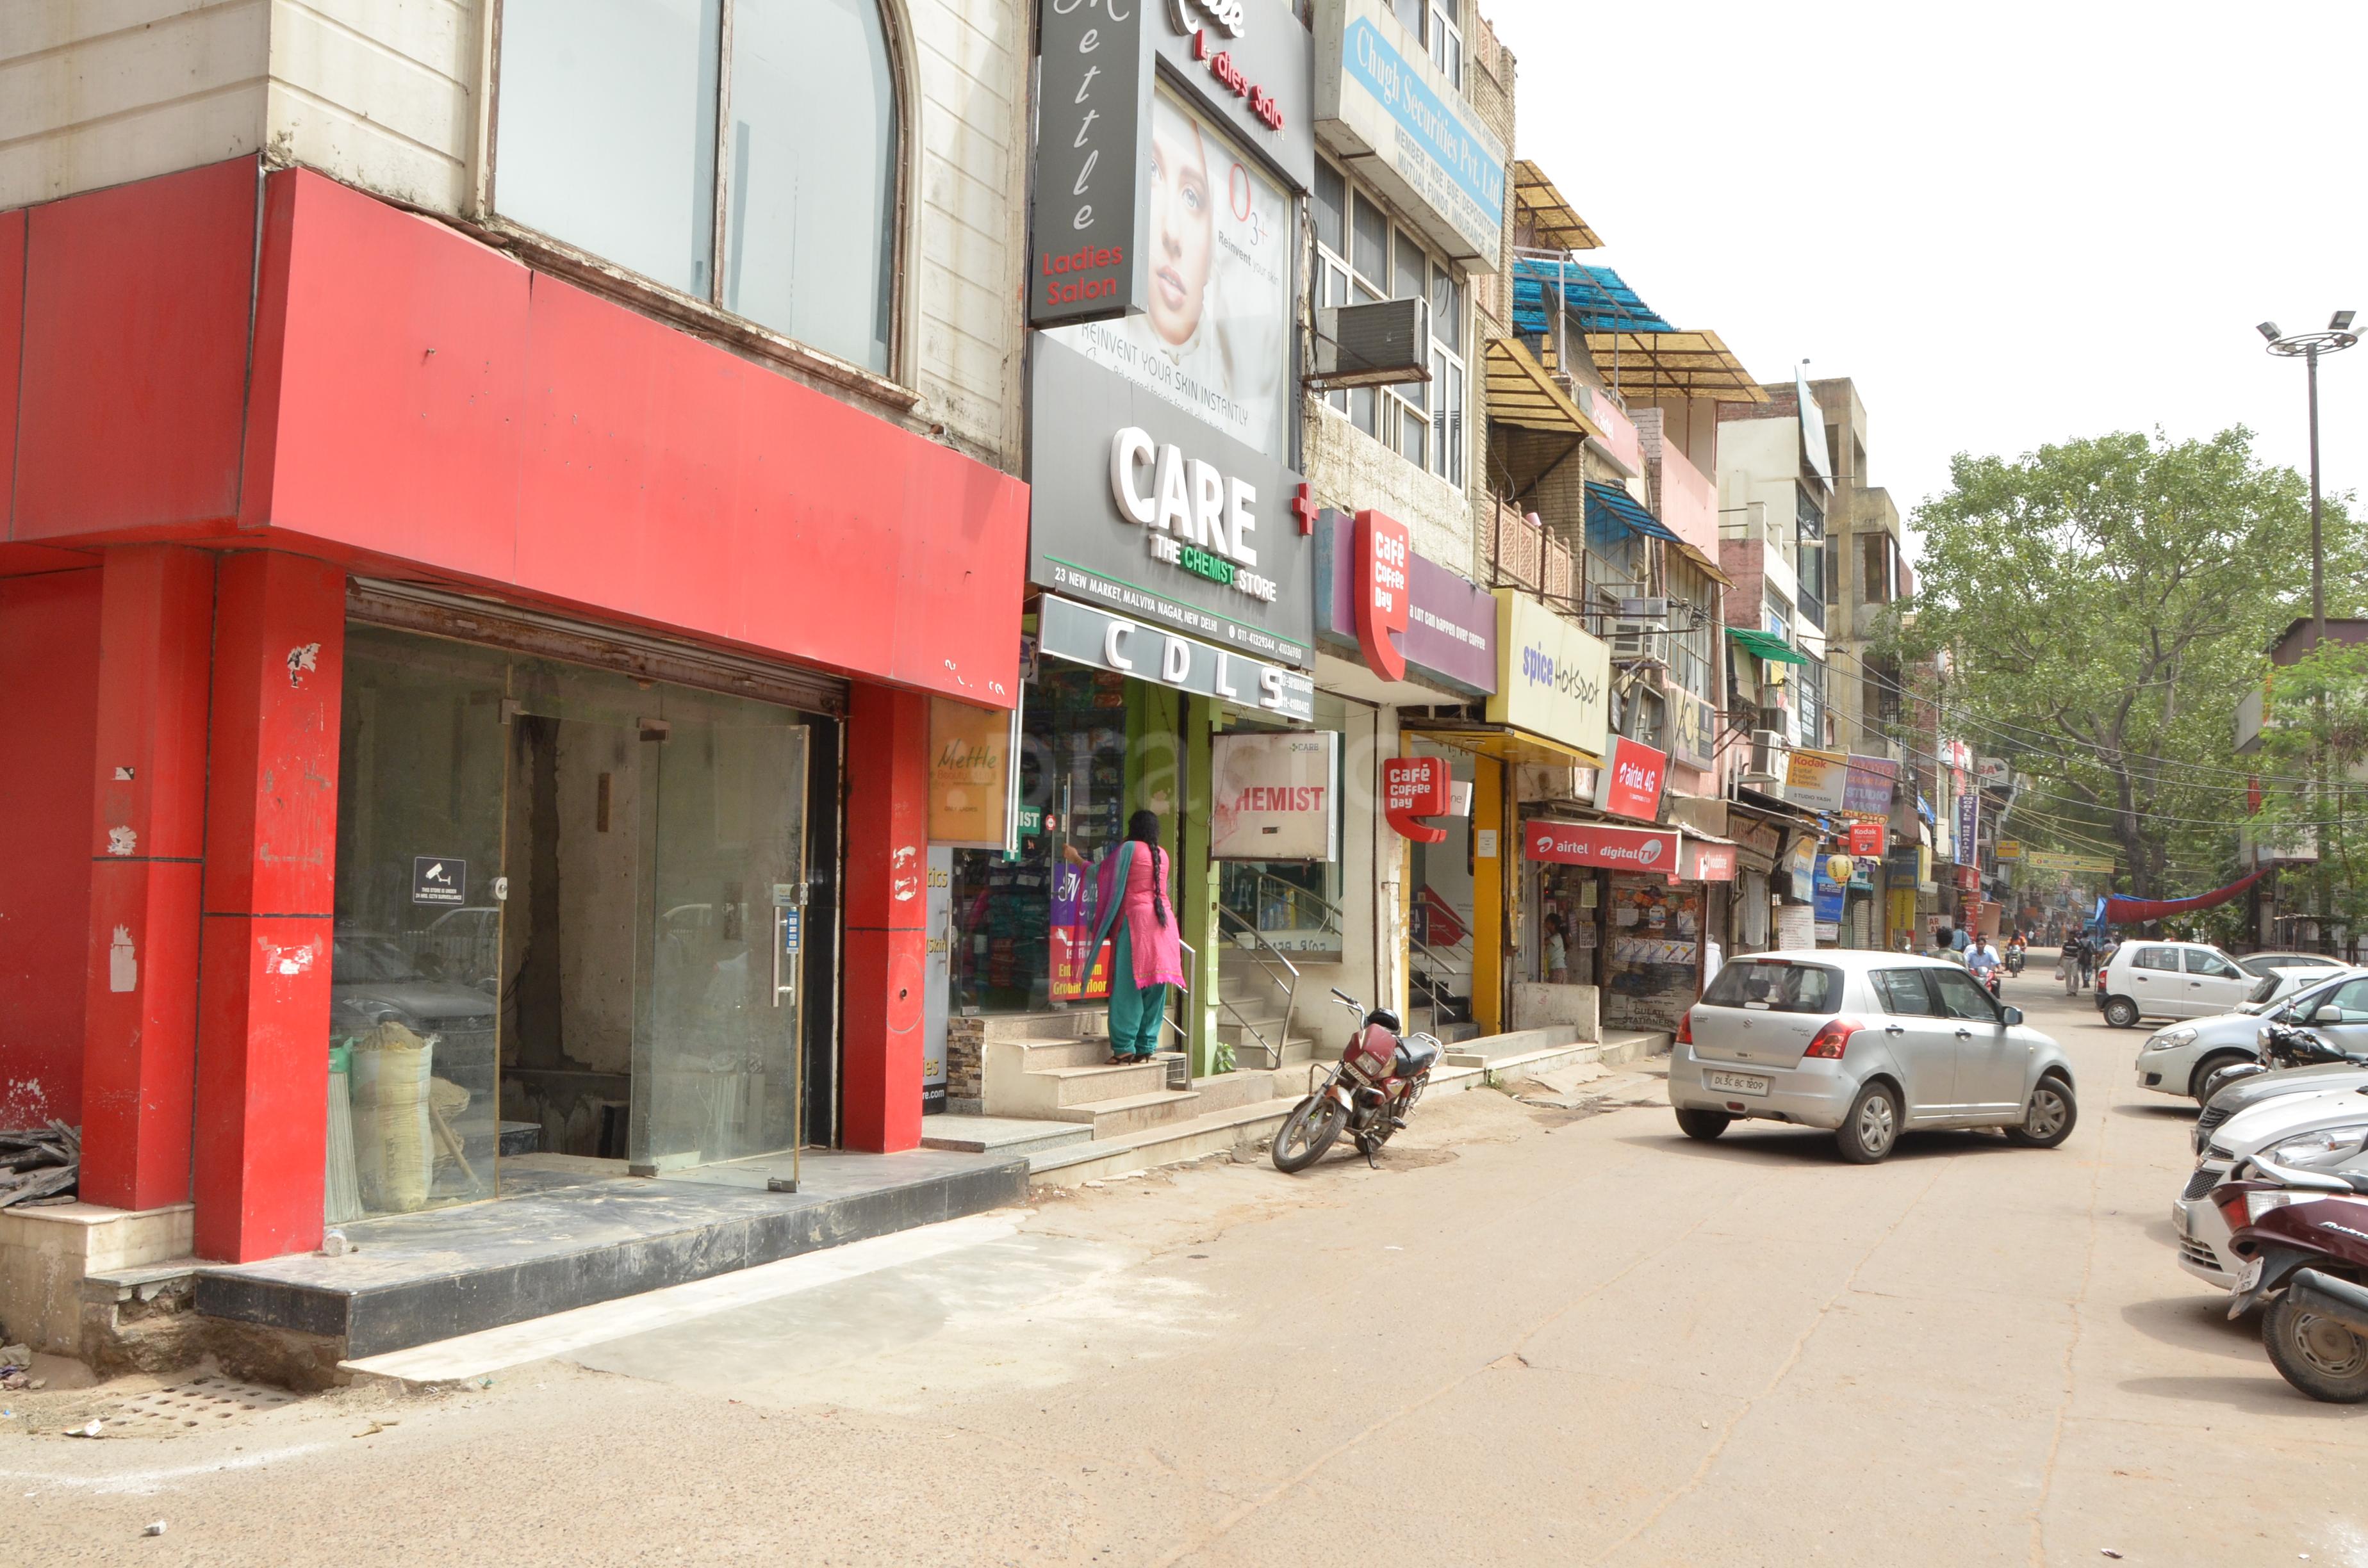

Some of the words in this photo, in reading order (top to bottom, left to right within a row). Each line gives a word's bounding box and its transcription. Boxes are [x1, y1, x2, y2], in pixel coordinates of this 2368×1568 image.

[1194, 29, 1248, 97] Ldies
[1250, 85, 1285, 137] Salo
[1356, 26, 1400, 104] Chugh
[1403, 76, 1458, 165] Securities
[1460, 135, 1480, 189] Pvt.
[1482, 163, 1502, 211] Ltd.
[1395, 124, 1425, 168] MEMBER
[1431, 164, 1443, 186] NSE
[1447, 181, 1459, 204] BSE
[1462, 196, 1499, 241] DEPOSITORY
[1397, 151, 1426, 196] MUTUAL
[1427, 183, 1449, 216] FUNDS
[1451, 206, 1486, 253] INSURANCE
[1488, 242, 1498, 264] IPO
[1042, 245, 1123, 275] Ladies
[1219, 230, 1251, 266] Reinvent
[1252, 259, 1266, 277] your
[1267, 271, 1279, 288] skin
[1047, 276, 1116, 306] Salon
[1081, 322, 1138, 366] REINVENT
[1142, 351, 1172, 385] YOUR
[1176, 372, 1198, 401] SKIN
[1201, 386, 1248, 427] INSTANTLY
[1110, 427, 1258, 567] CARE
[1149, 533, 1181, 566] THE
[1180, 546, 1236, 585] CHEMIST
[1234, 569, 1277, 603] STORE
[1375, 560, 1404, 590] Coffee
[1054, 568, 1066, 582] 23
[1069, 571, 1087, 591] NEW
[1089, 577, 1122, 603] MARKET,
[1123, 589, 1156, 612] MALVIYA
[1158, 601, 1183, 623] NAGAR,
[1184, 612, 1199, 627] NEW
[1201, 617, 1217, 633] DELHI
[1374, 586, 1392, 613] Day
[1425, 610, 1436, 628] can
[1436, 616, 1456, 639] happen
[1468, 632, 1486, 651] coffee
[1523, 641, 1554, 687] spice
[937, 738, 997, 771] Mettle
[1298, 742, 1319, 751] CARE
[1390, 764, 1431, 783] Café
[1625, 762, 1645, 790] airtel
[1645, 770, 1656, 793] 4G
[1794, 756, 1827, 769] Kodak
[1390, 783, 1431, 796] Coffee
[1390, 797, 1413, 809] Day
[1846, 787, 1889, 802] STUDIO
[1017, 811, 1040, 828] IST
[1850, 800, 1882, 813] YASH
[1962, 796, 1973, 821] MOBILE
[1557, 841, 1588, 854] airtel
[1600, 845, 1638, 860] digital
[1641, 849, 1658, 862] TV
[1623, 1016, 1676, 1026] STATIONERS
[1634, 1008, 1665, 1017] GULATI
